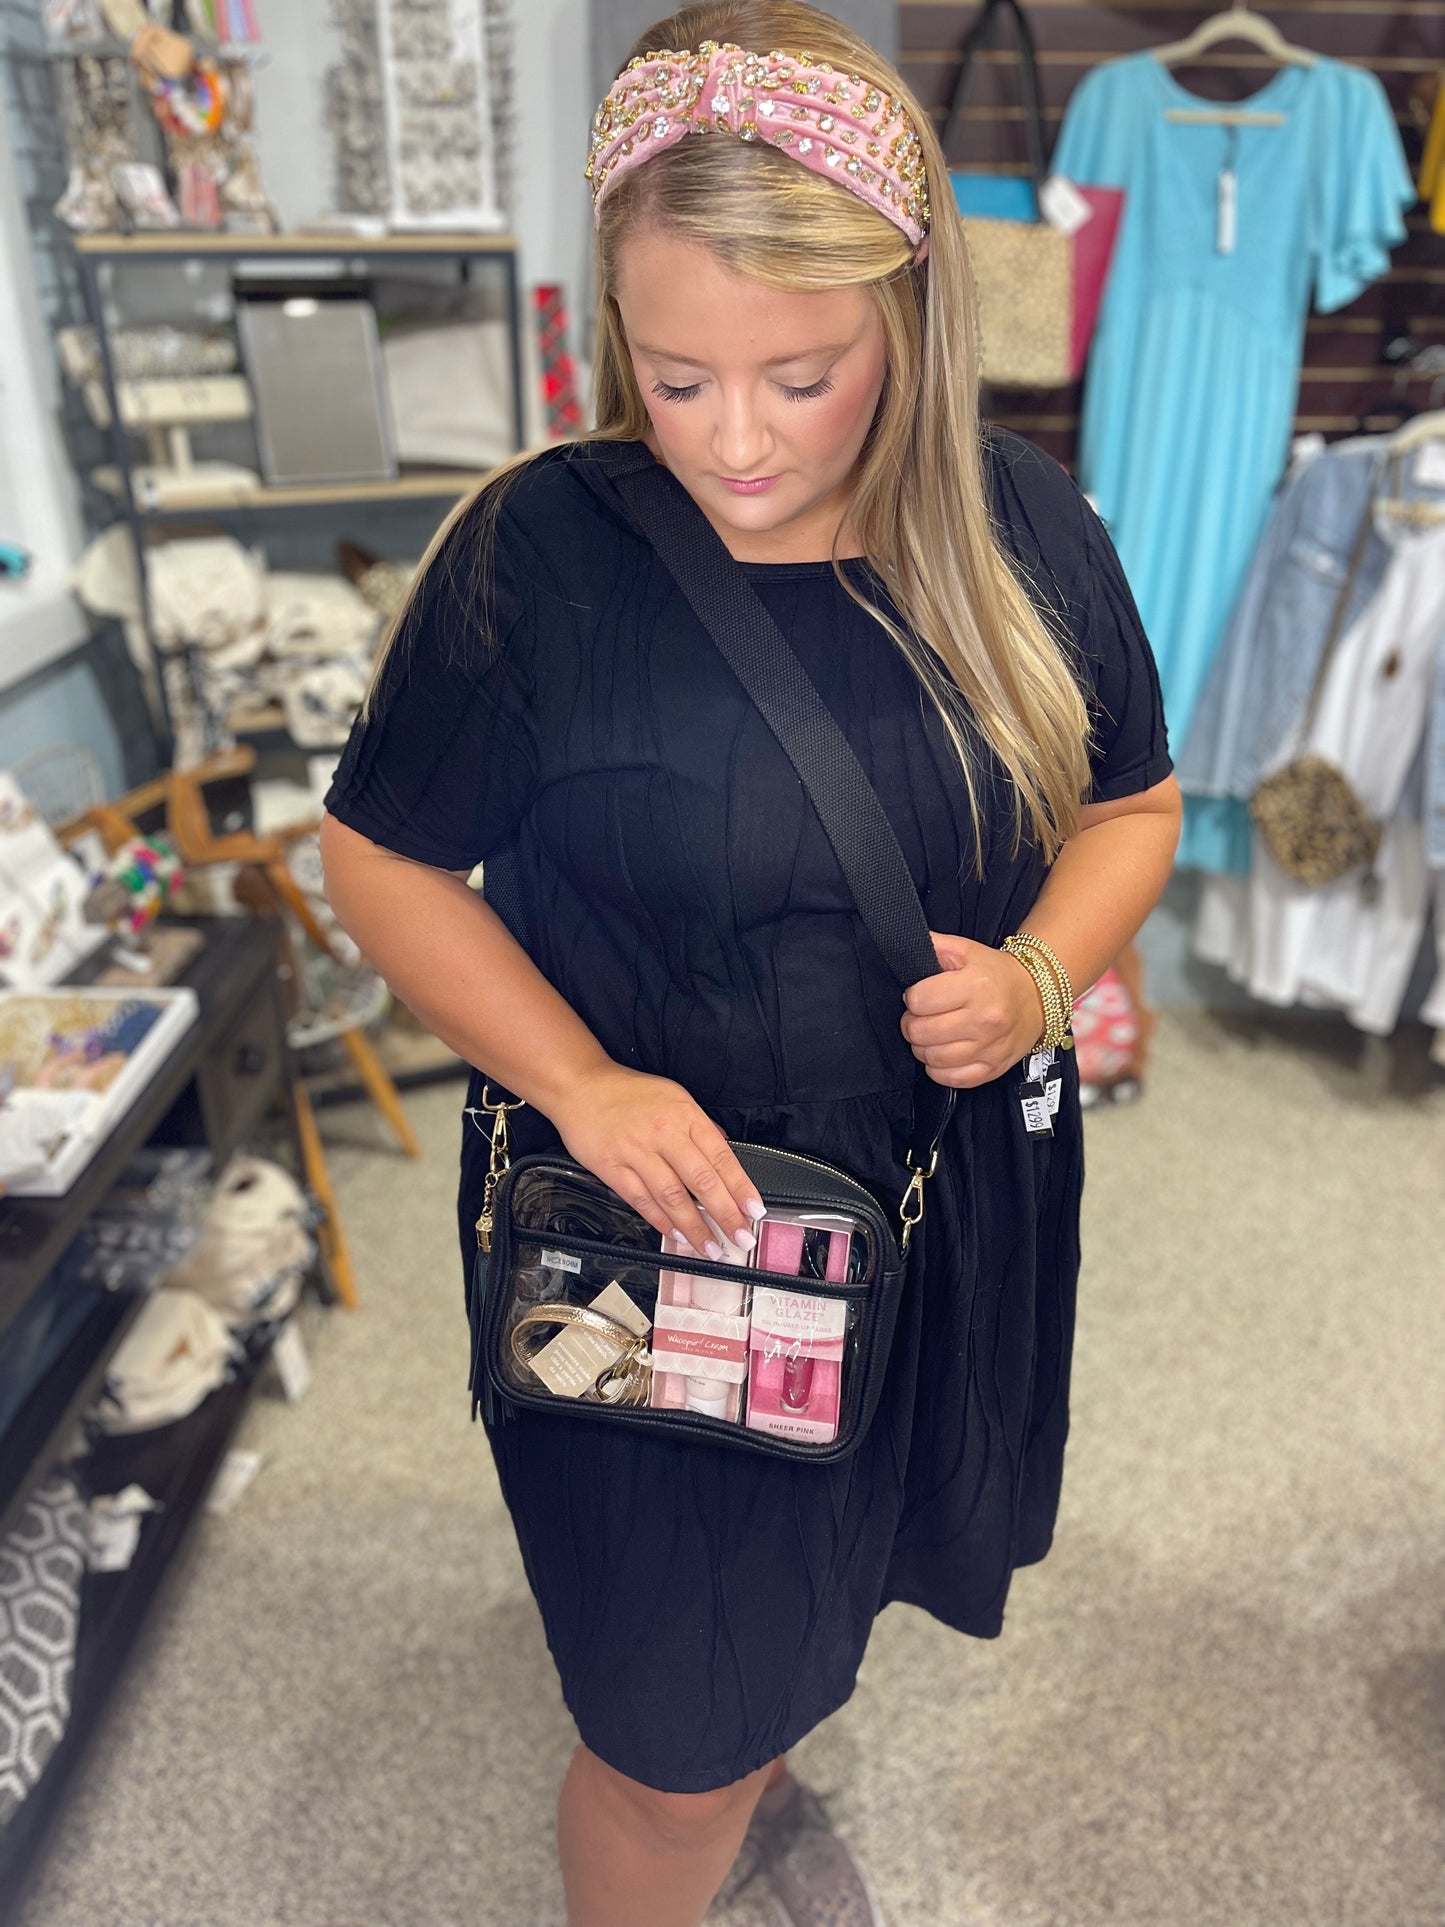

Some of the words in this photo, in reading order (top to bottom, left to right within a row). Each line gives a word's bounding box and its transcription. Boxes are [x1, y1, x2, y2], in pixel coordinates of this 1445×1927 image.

[1025, 1100, 1044, 1128] $1299
[770, 1296, 827, 1311] VITAMIN
[769, 1423, 794, 1432] SHEER
[796, 1427, 815, 1435] PINK
